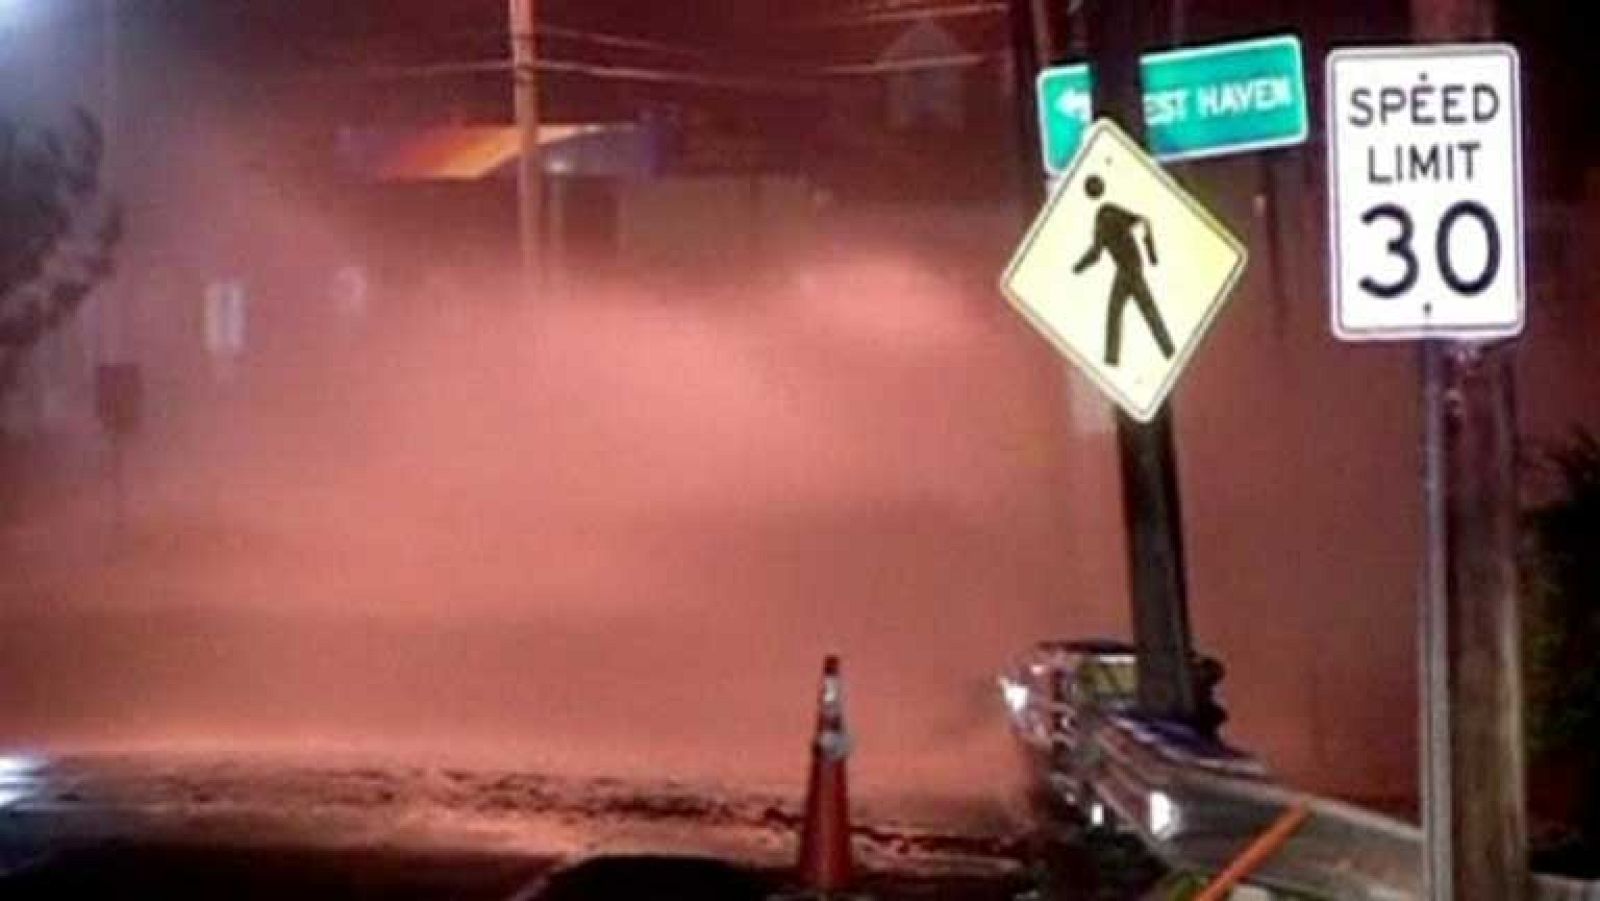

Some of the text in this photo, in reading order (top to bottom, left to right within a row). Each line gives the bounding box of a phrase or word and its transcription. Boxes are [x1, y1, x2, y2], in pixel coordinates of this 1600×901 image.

[1143, 77, 1293, 125] EST HAVEN
[1349, 83, 1500, 127] SPEED
[1367, 140, 1482, 184] LIMIT
[1358, 200, 1502, 299] 30
